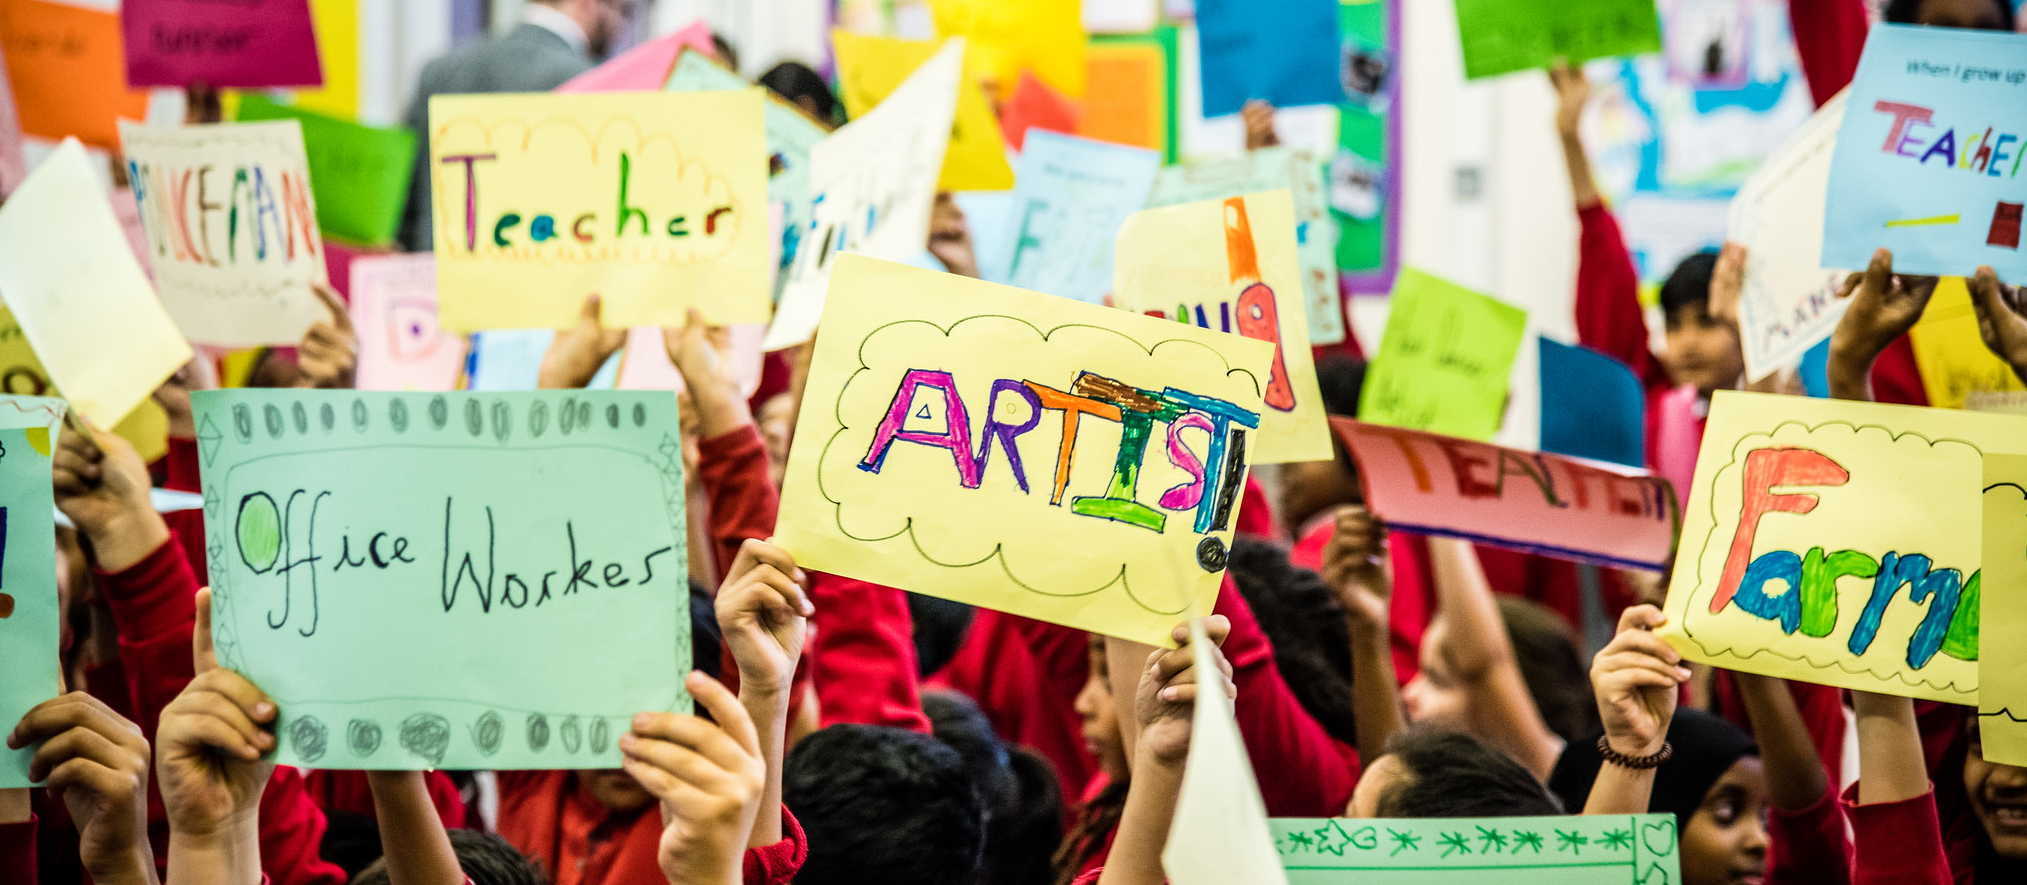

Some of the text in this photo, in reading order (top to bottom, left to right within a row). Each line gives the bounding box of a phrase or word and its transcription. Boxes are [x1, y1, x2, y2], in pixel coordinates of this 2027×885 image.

[1905, 58, 1950, 80] When
[1961, 67, 2002, 84] grow
[2005, 69, 2027, 87] up
[441, 152, 733, 252] Teacher
[857, 369, 1260, 573] ARTIST!
[235, 489, 671, 637] Office Worker
